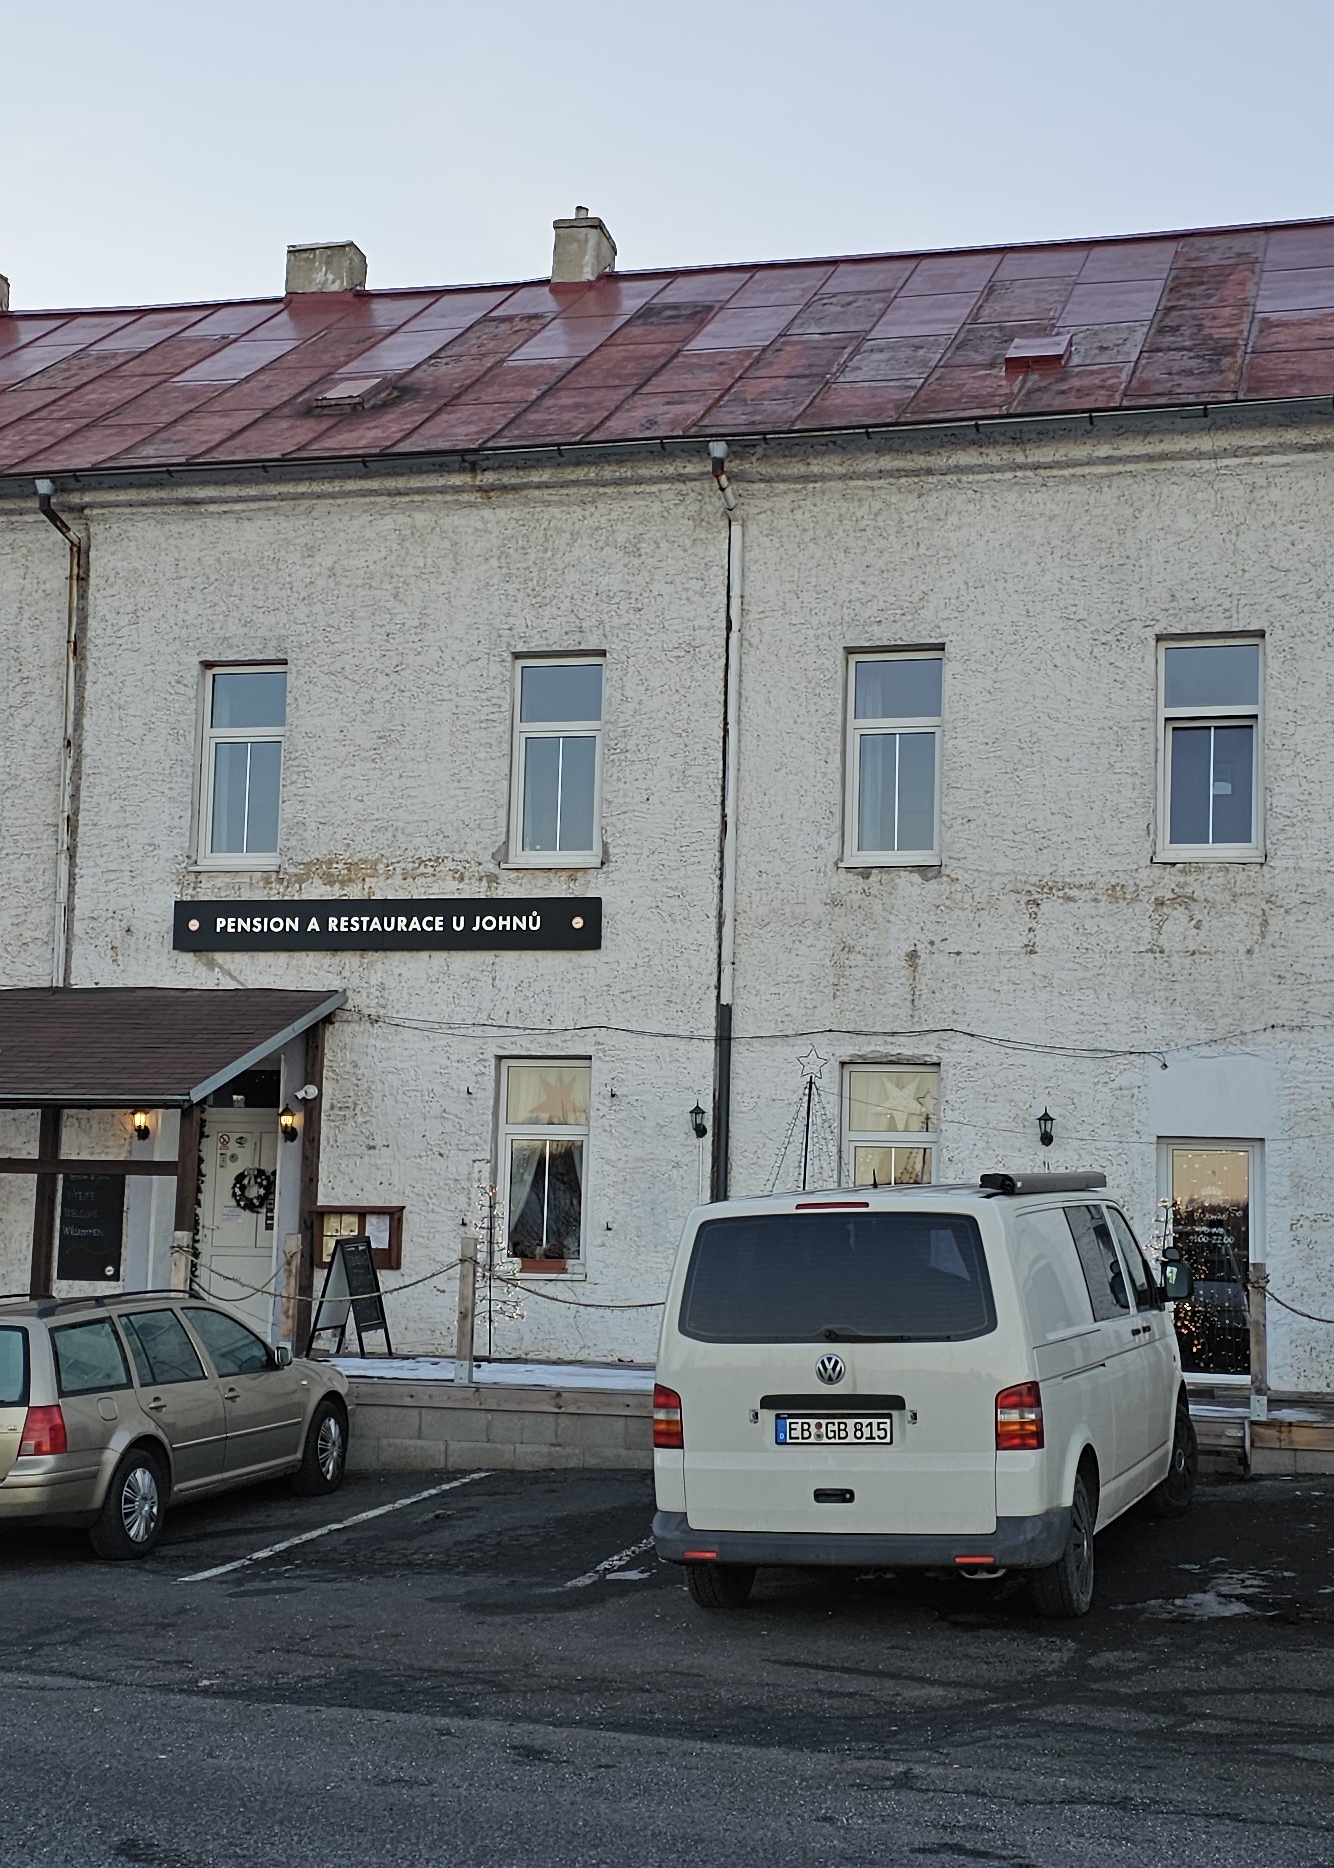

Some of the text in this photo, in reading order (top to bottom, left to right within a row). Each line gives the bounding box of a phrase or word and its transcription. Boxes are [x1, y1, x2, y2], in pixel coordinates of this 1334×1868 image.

[215, 910, 541, 933] PENSION A RESTAURACE U JOHNŮ
[788, 1422, 812, 1440] EB
[825, 1422, 849, 1440] GB
[853, 1422, 888, 1441] 815
